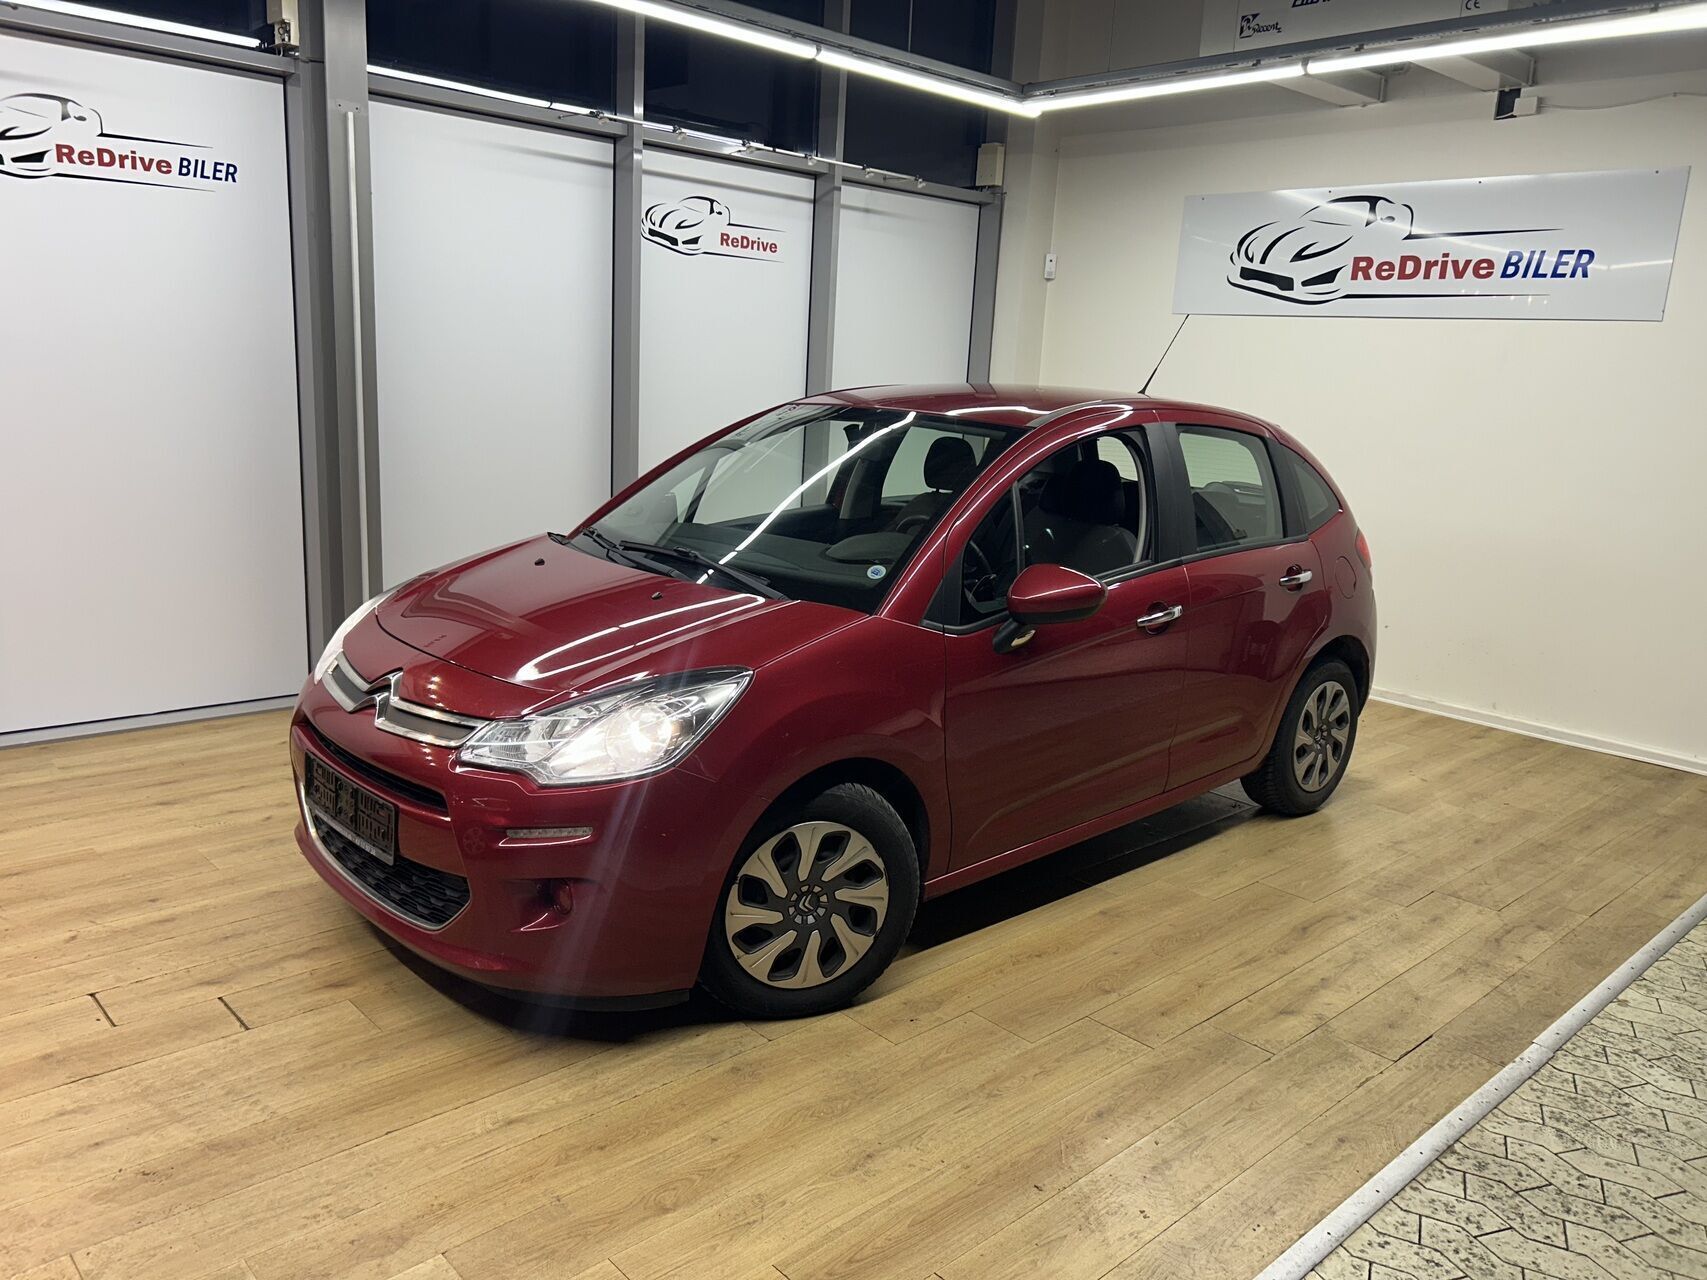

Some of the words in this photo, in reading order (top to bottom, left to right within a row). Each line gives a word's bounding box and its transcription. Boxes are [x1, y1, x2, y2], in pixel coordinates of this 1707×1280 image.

[55, 143, 173, 175] ReDrive
[177, 156, 238, 183] BILER
[720, 232, 778, 254] ReDrive
[1350, 252, 1496, 281] ReDrive
[1499, 249, 1596, 279] BILER
